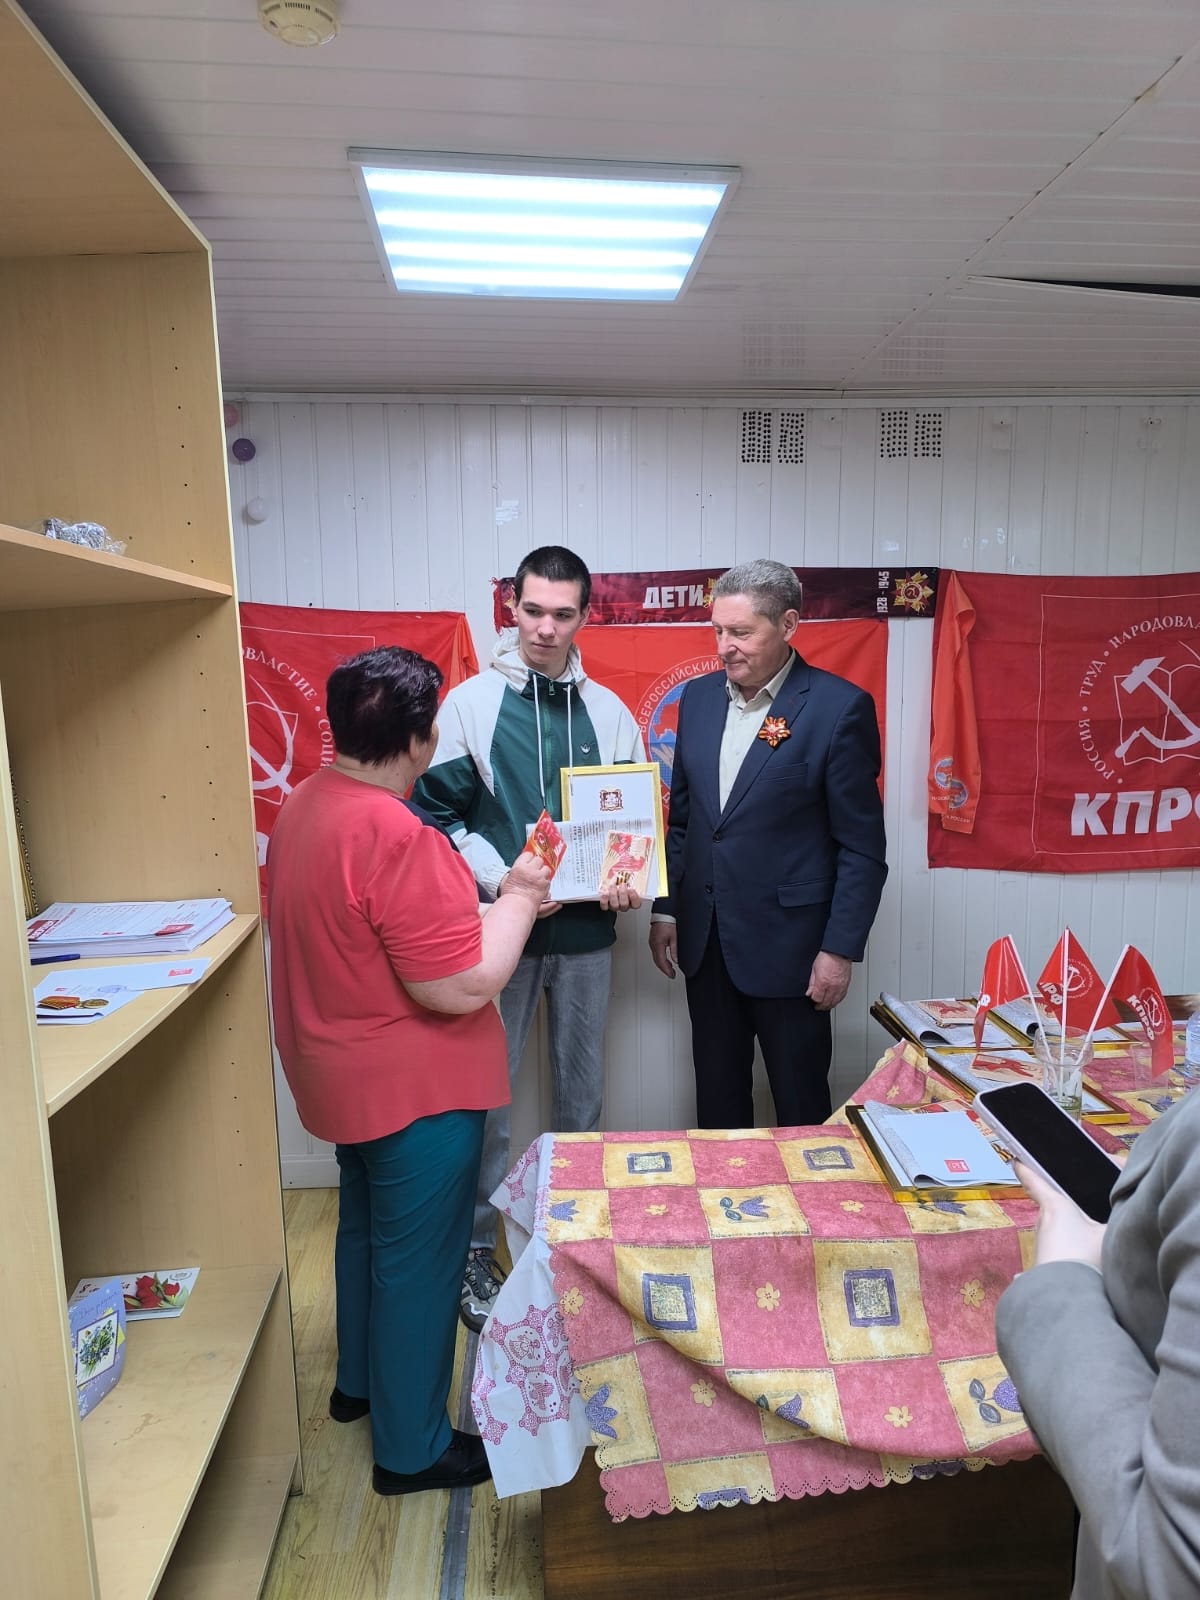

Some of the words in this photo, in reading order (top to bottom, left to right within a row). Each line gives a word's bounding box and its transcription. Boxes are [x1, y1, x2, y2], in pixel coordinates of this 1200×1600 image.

[642, 585, 704, 609] ДЕТИ
[878, 571, 890, 589] 1945
[639, 657, 719, 733] ВСЕРОССИЙСКИЙ
[1079, 660, 1107, 697] ТРУД
[1079, 718, 1114, 780] РОССИЯ
[1127, 994, 1155, 1041] КПРФ
